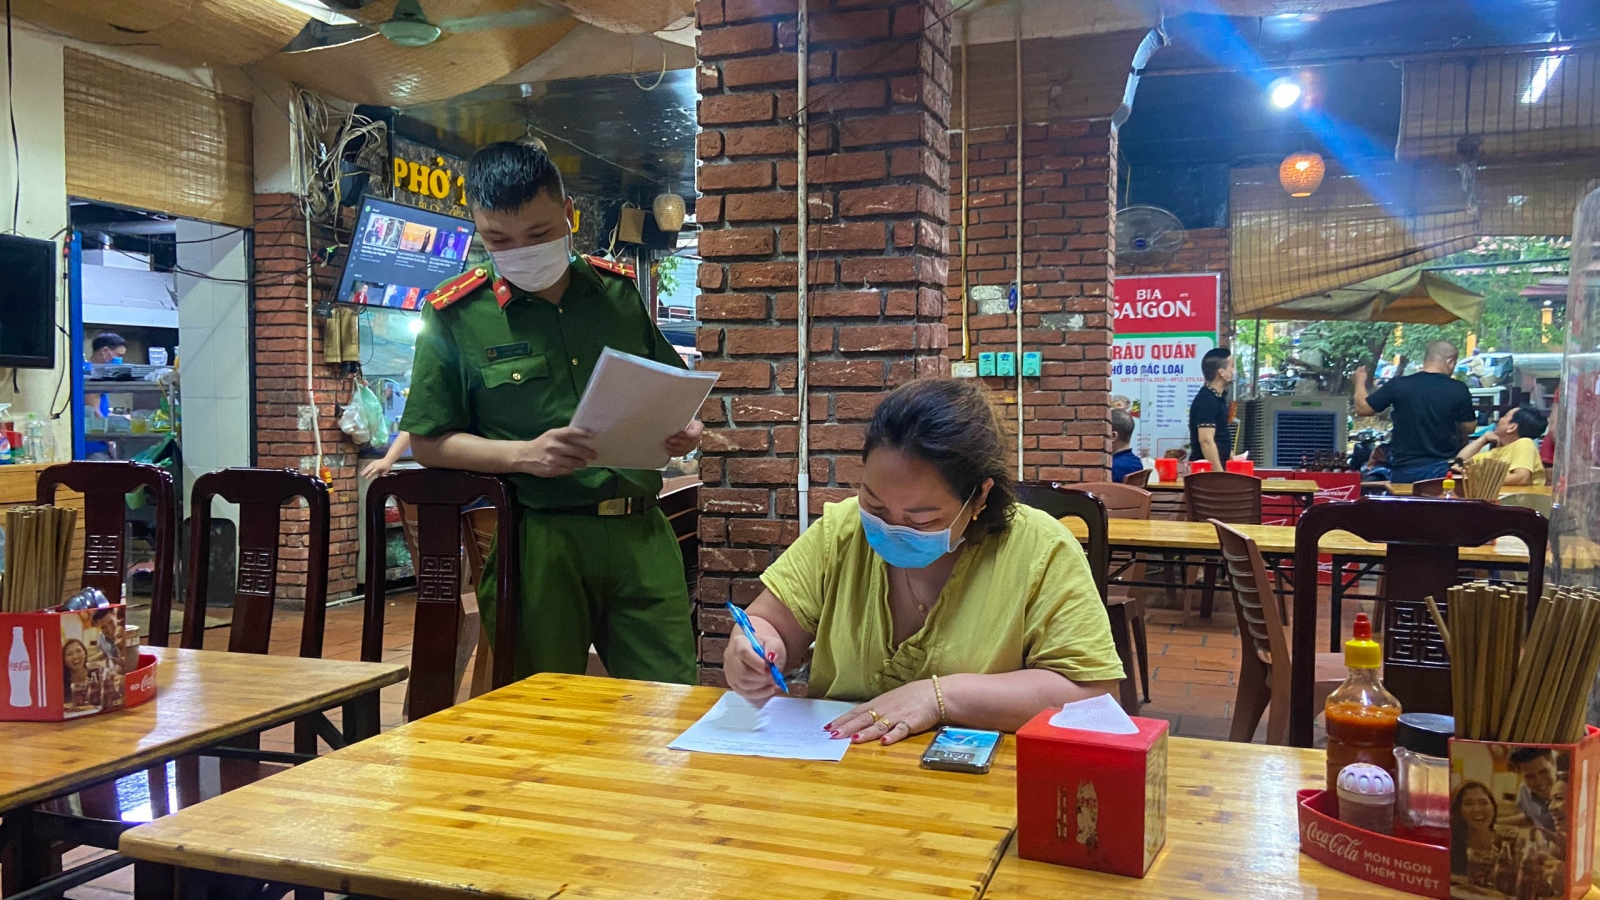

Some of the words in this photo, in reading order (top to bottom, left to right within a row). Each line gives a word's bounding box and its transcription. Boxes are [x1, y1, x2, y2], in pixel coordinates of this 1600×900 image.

[394, 157, 451, 199] PHỞ
[1136, 289, 1162, 300] BIA
[1112, 342, 1145, 360] RÂU
[1151, 341, 1196, 360] QUÁN
[1112, 363, 1123, 375] HỞ
[1162, 364, 1184, 376] LOẠI
[1307, 822, 1362, 861] Coca-Cola
[1394, 858, 1432, 874] NGON
